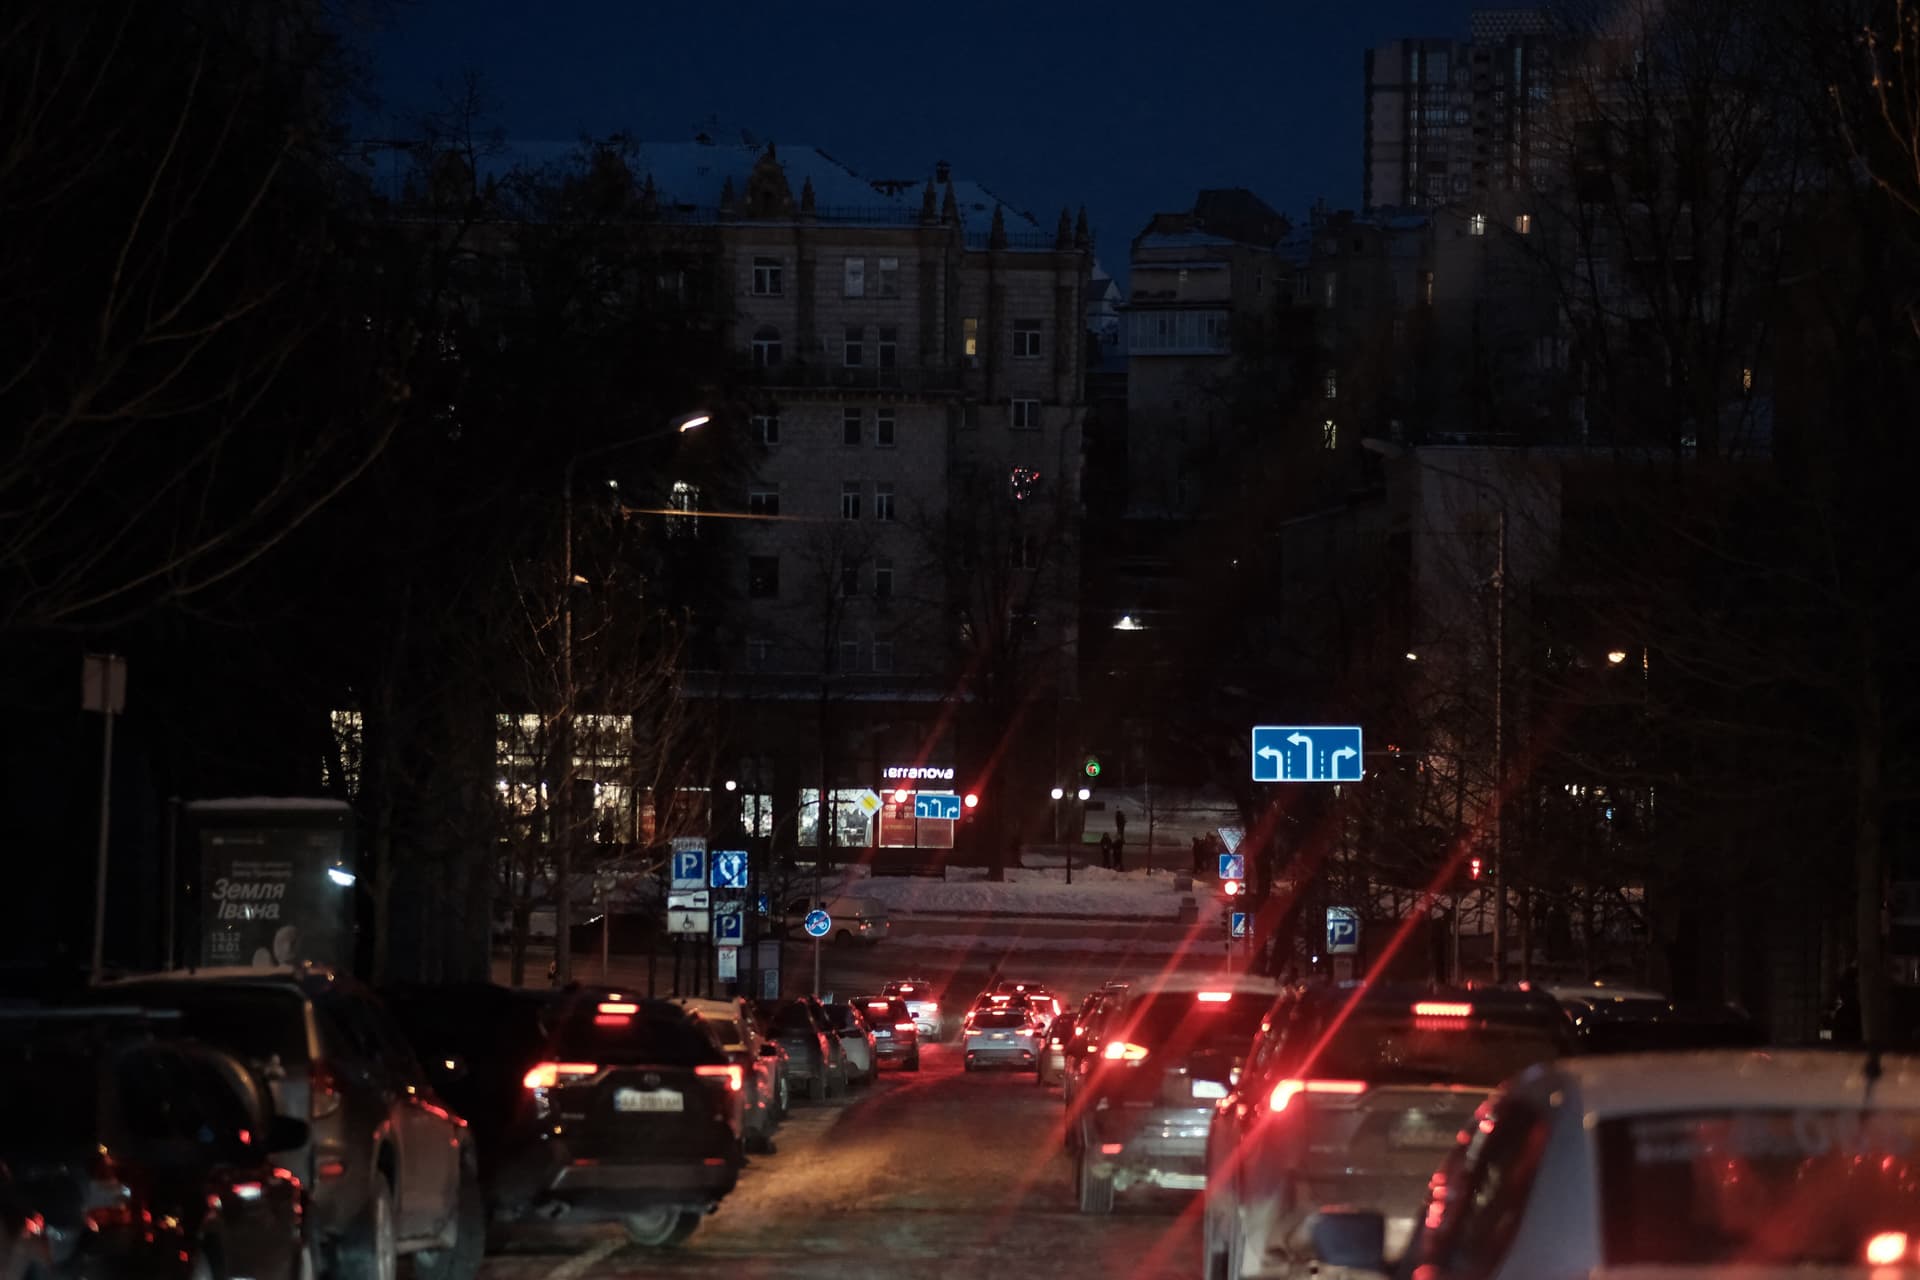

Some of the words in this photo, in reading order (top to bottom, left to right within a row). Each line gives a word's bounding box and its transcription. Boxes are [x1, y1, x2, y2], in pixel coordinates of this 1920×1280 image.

[682, 853, 698, 878] P
[212, 878, 286, 900] Земля
[217, 899, 280, 919] Івана
[722, 916, 737, 937] P
[1334, 922, 1353, 943] P
